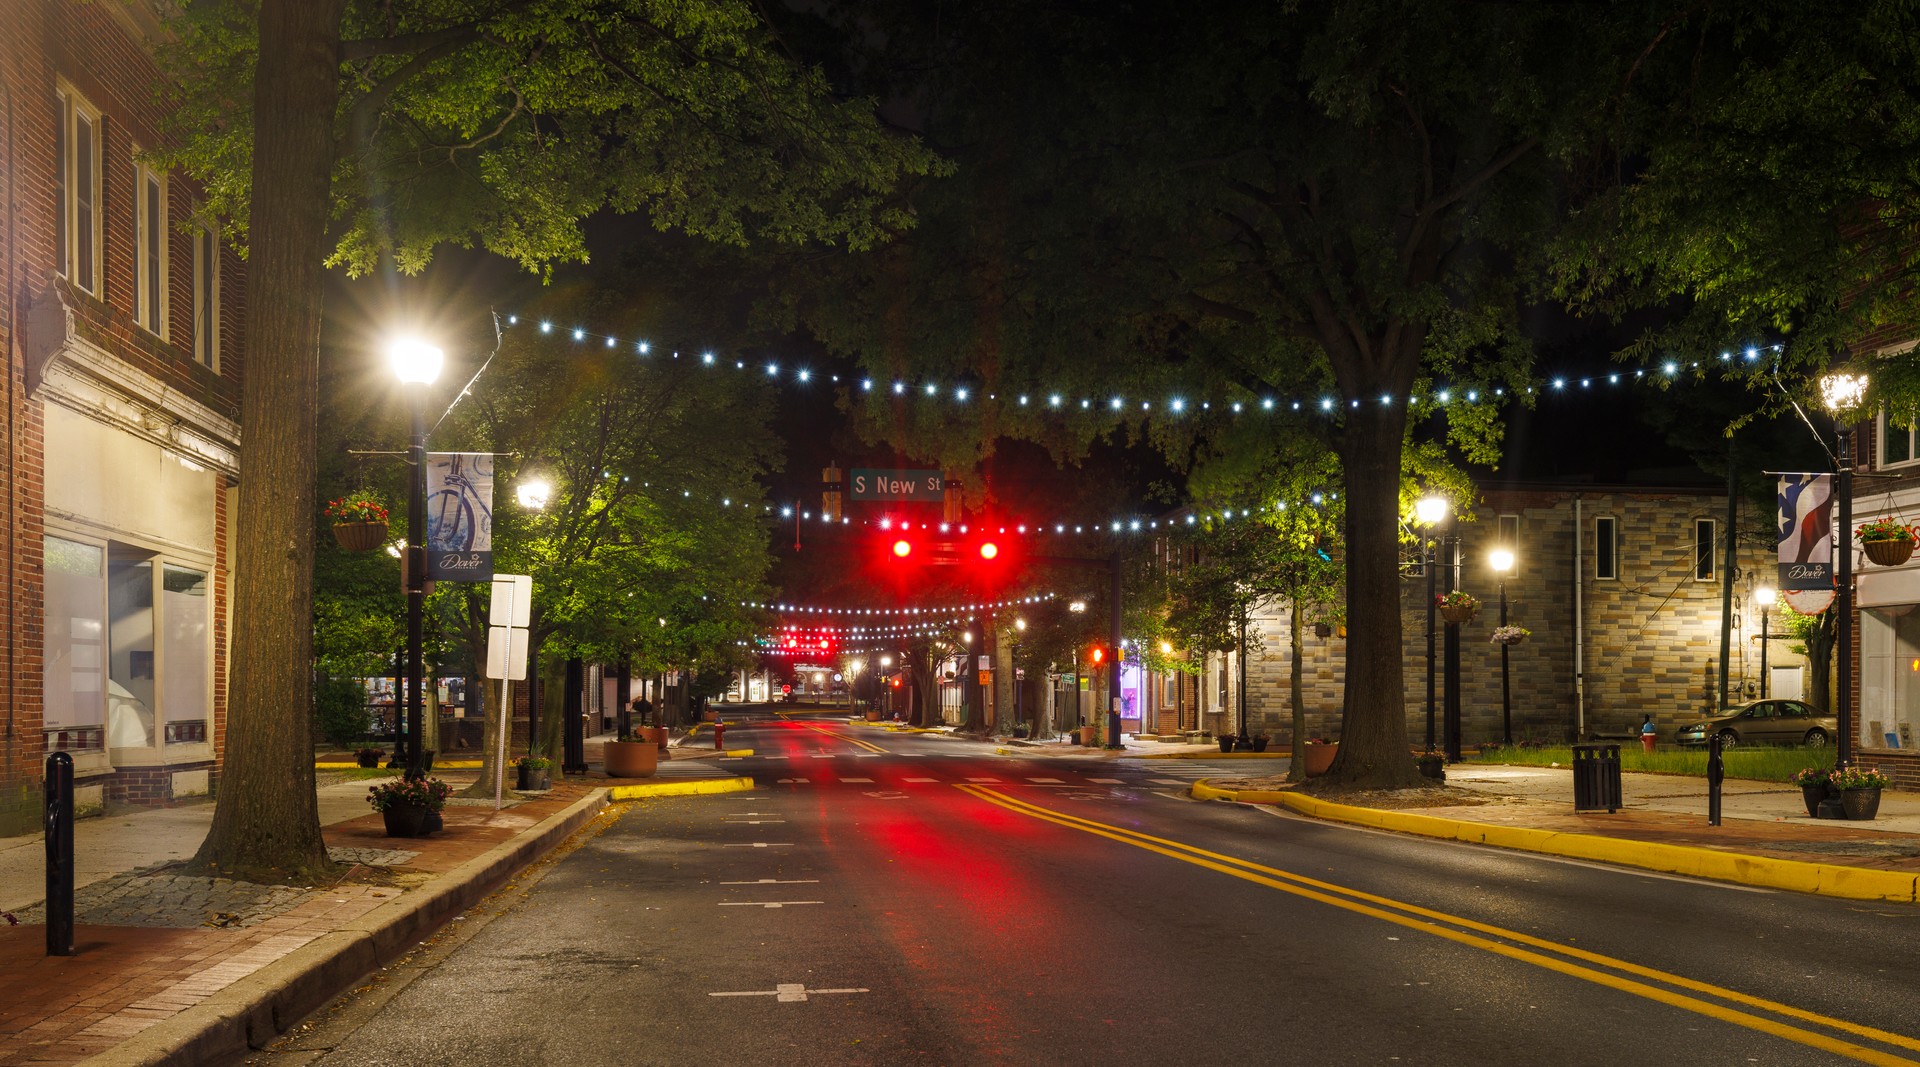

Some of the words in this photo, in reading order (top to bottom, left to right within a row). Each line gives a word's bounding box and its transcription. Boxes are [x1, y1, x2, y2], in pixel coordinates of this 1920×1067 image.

[855, 476, 866, 494] S
[877, 476, 916, 494] New
[927, 477, 941, 491] St
[439, 553, 483, 569] Dover
[1788, 564, 1826, 579] Dover
